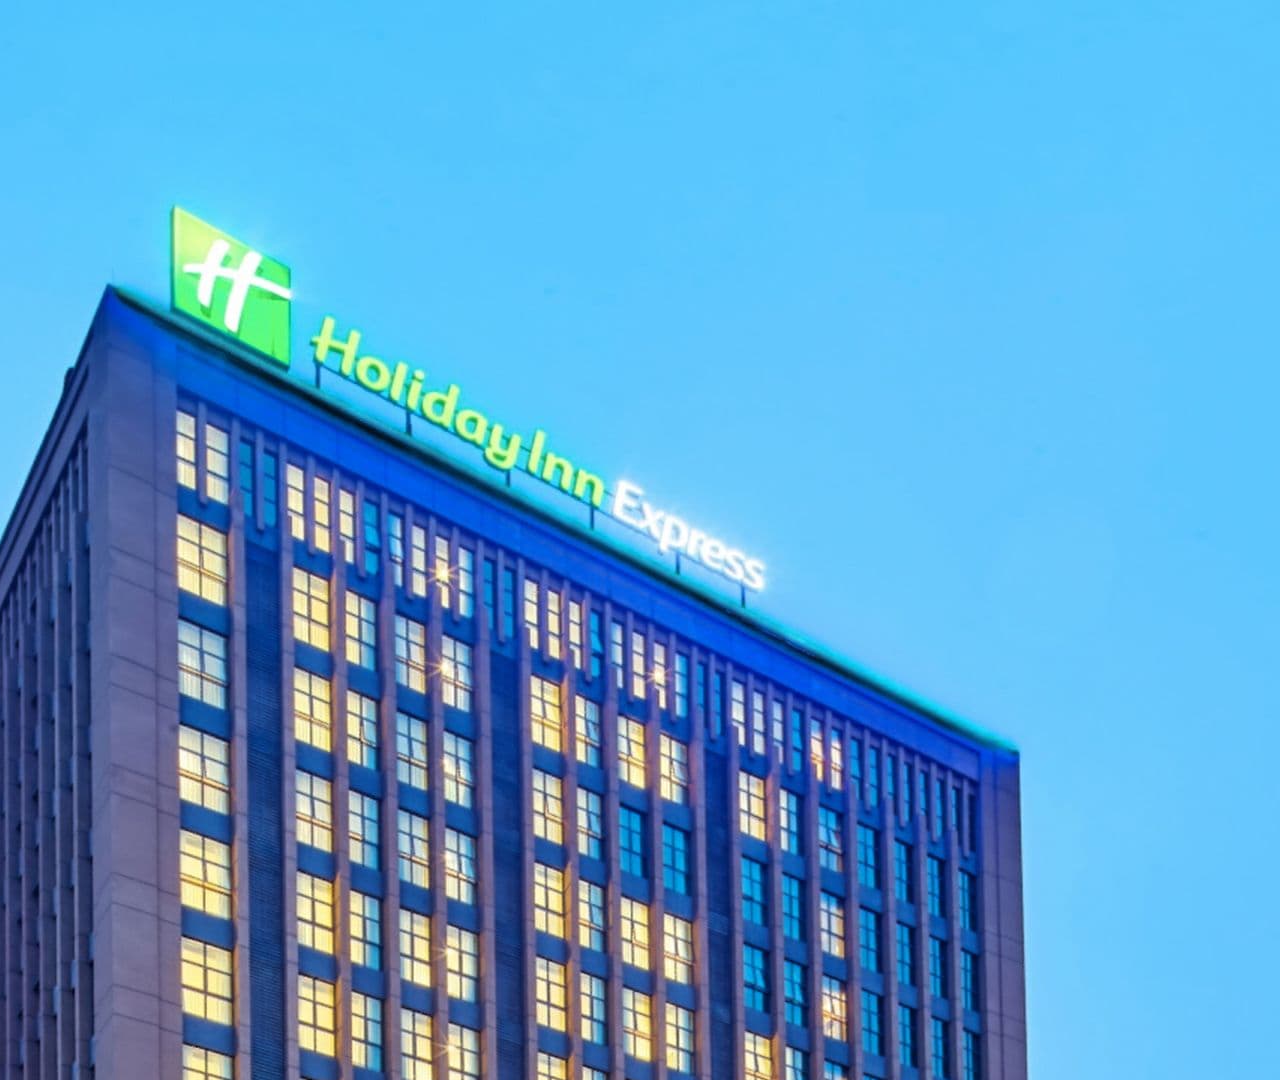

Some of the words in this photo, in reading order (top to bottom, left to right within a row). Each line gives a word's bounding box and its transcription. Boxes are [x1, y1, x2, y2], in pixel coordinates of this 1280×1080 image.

[310, 315, 522, 470] Holiday
[528, 429, 606, 508] Inn
[612, 478, 766, 592] Express
